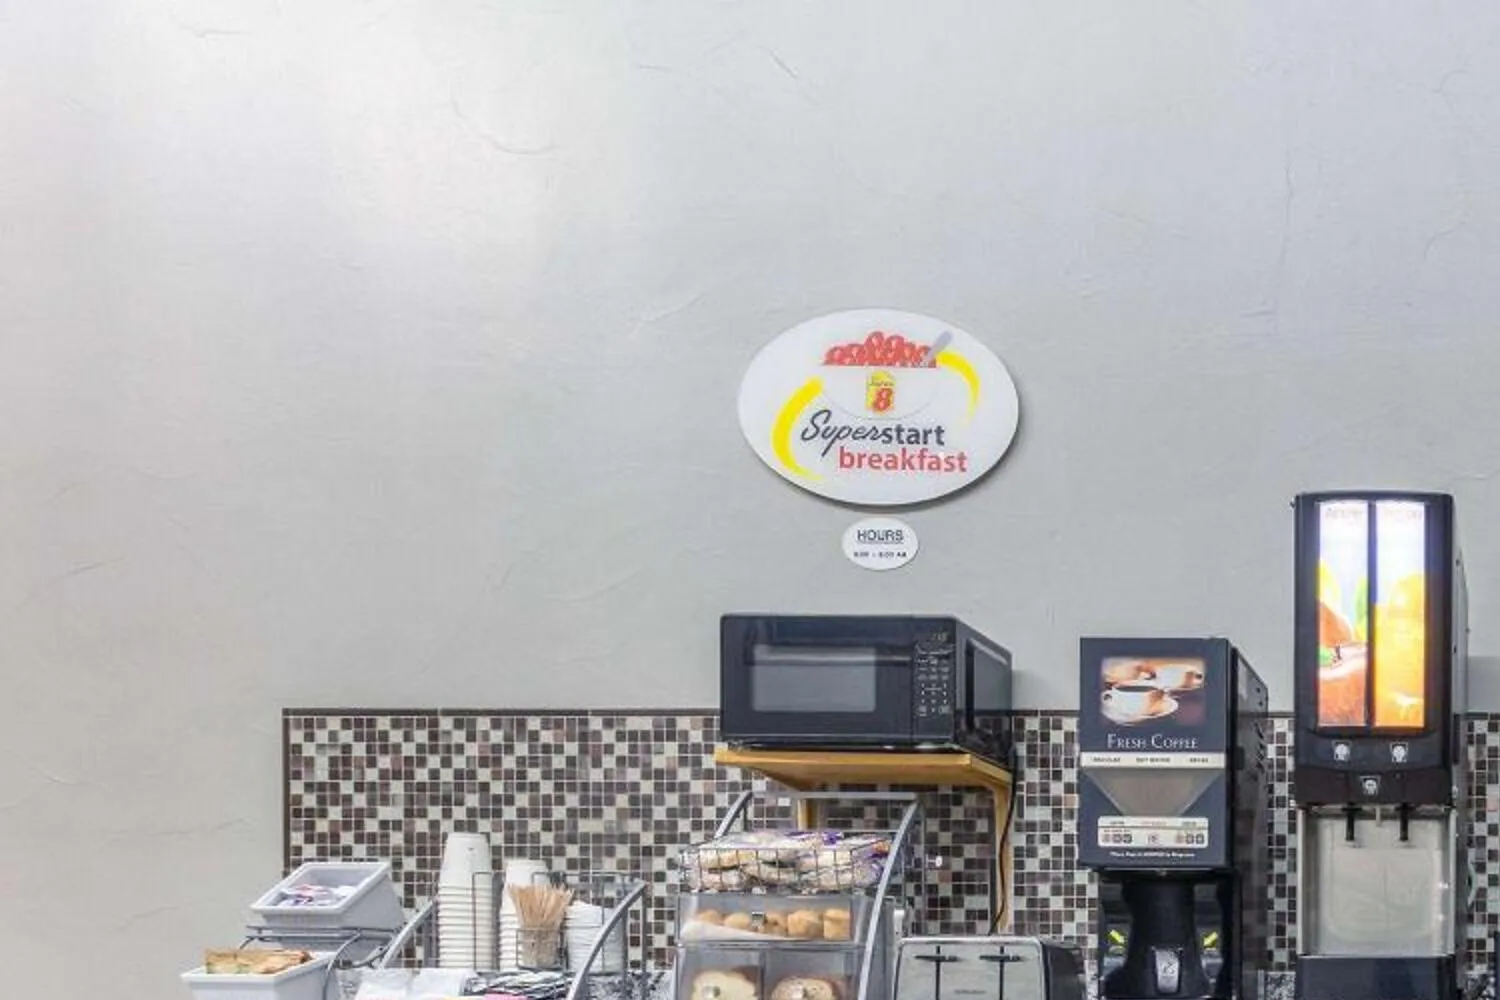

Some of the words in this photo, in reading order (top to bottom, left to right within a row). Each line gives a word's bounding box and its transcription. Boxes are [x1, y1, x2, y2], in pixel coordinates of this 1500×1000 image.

[801, 409, 945, 458] Superstart
[838, 447, 968, 472] breakfast
[857, 529, 904, 541] HOURS
